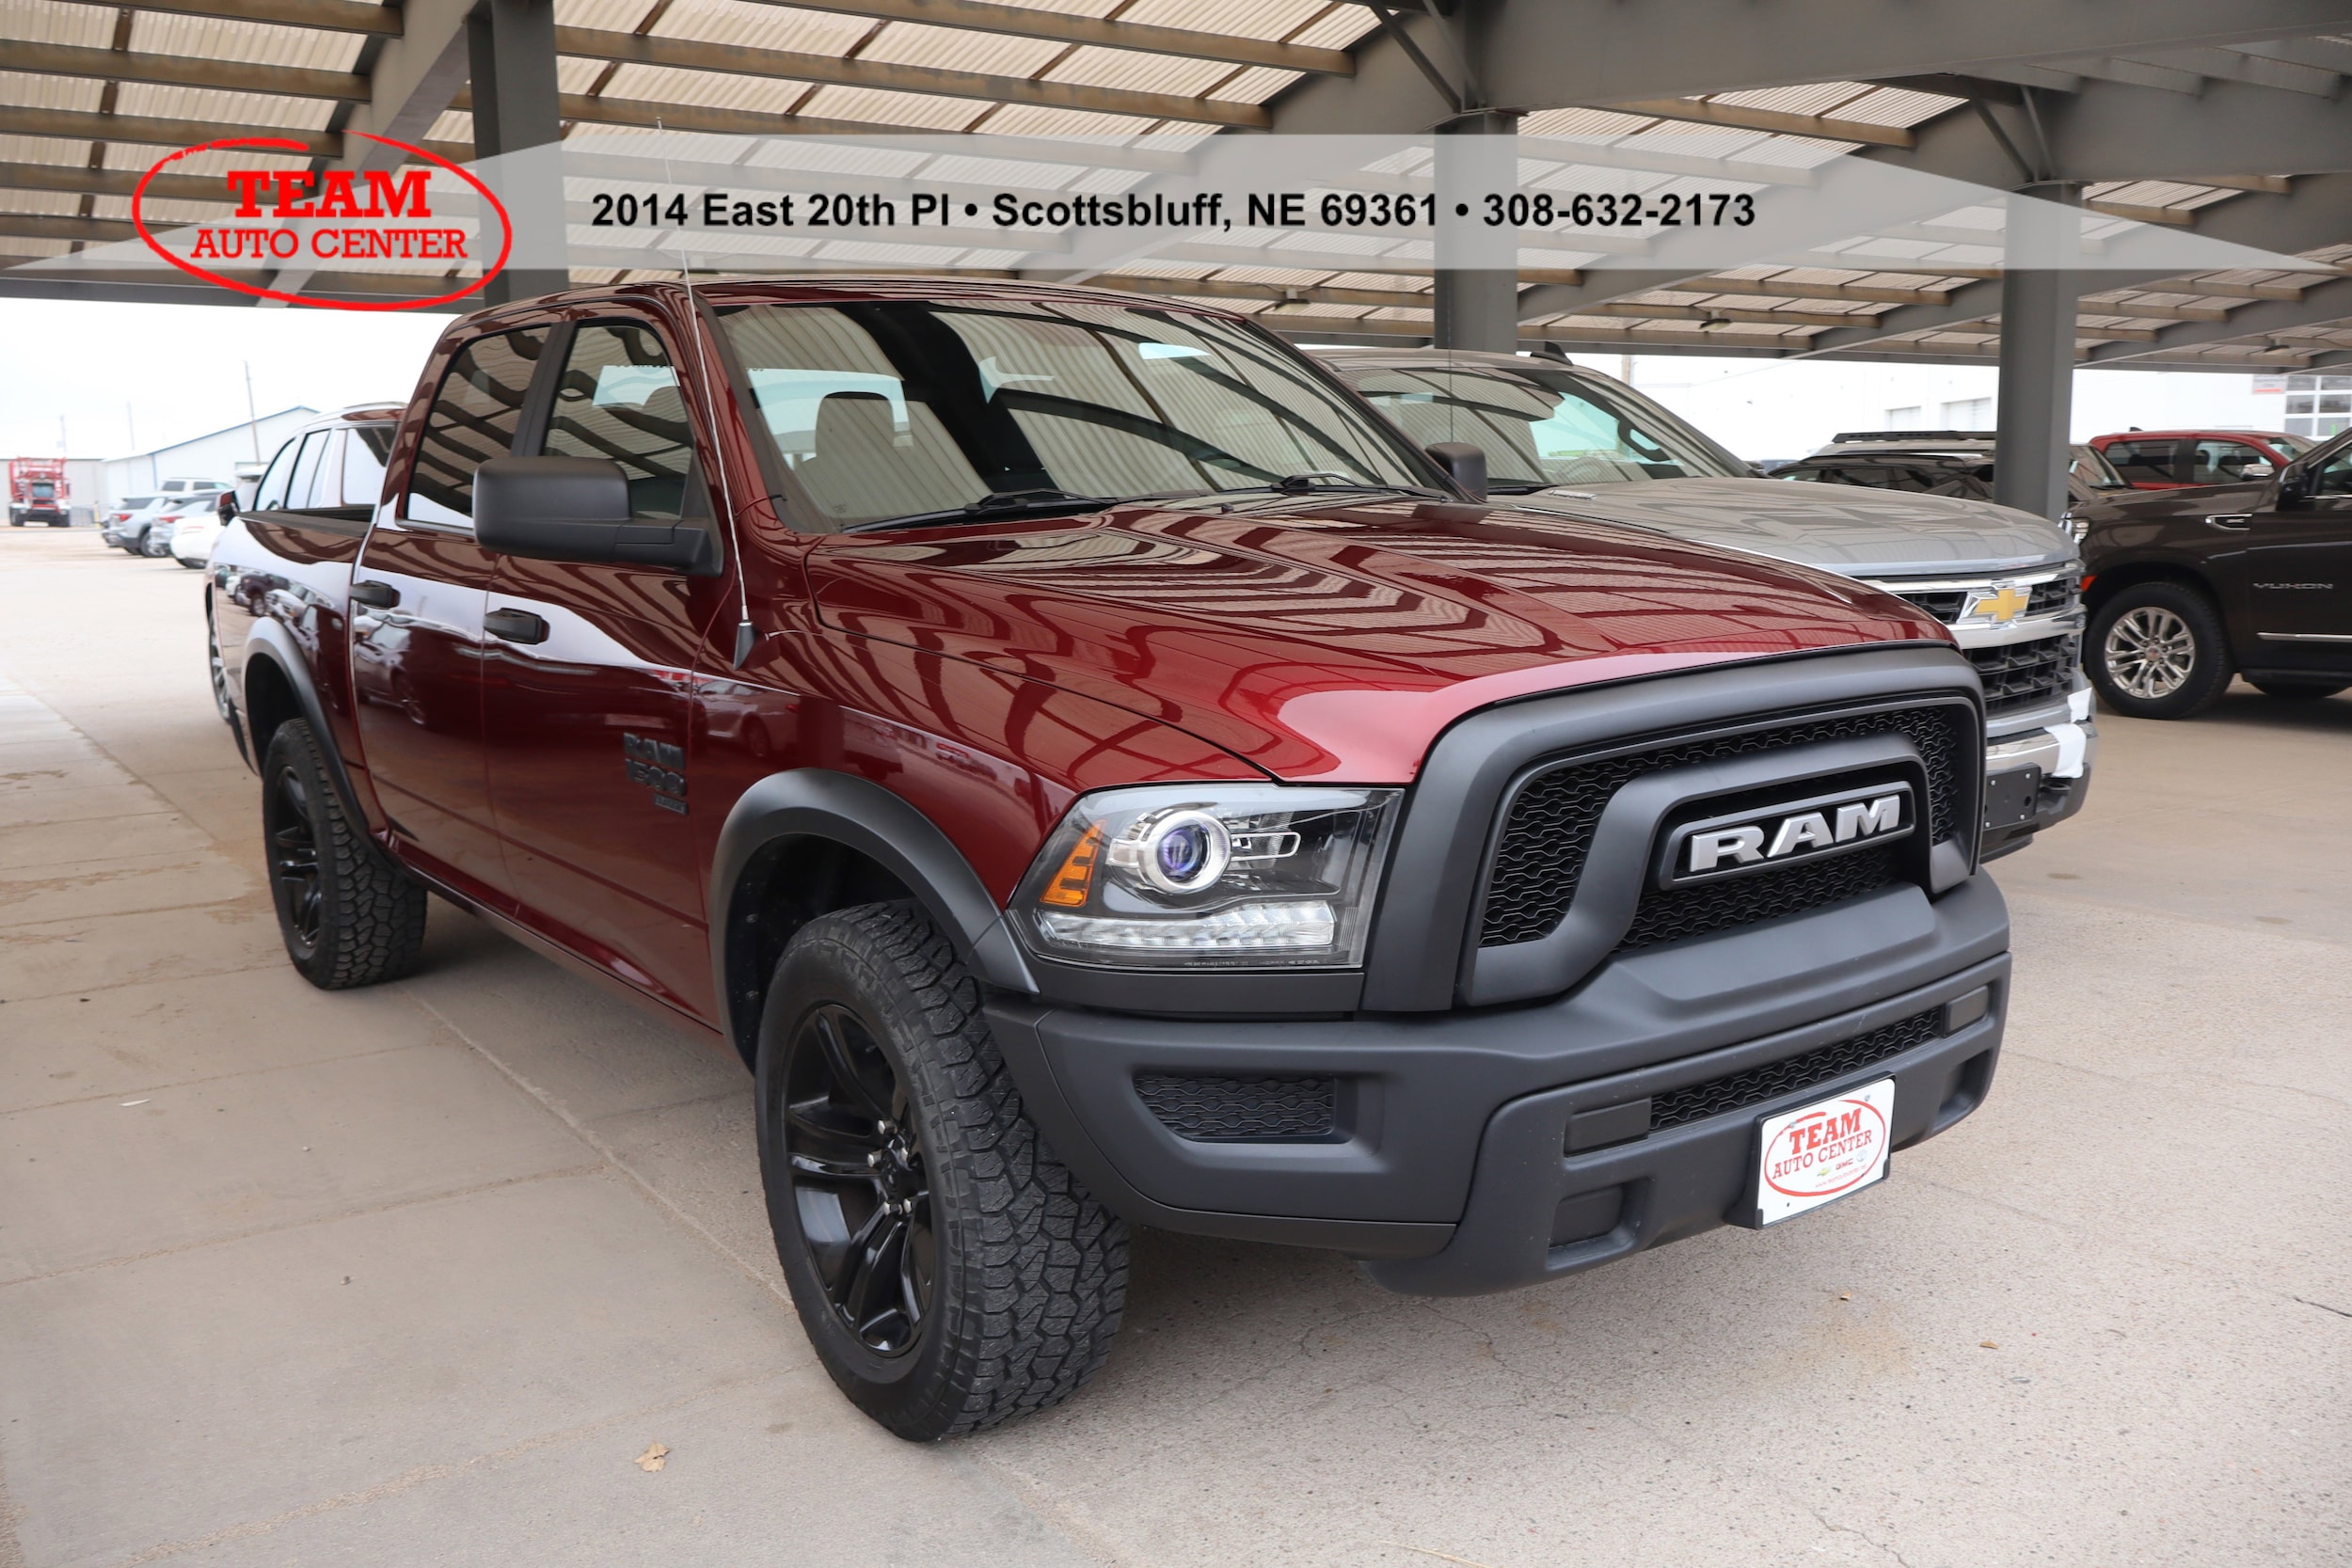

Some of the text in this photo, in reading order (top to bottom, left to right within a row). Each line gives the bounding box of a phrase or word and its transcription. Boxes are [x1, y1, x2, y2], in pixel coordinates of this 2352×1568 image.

[1690, 795, 1900, 872] RAM
[1772, 1151, 1814, 1180] AUTO
[1818, 1130, 1872, 1164] CENTER
[1789, 1108, 1862, 1155] TEAM
